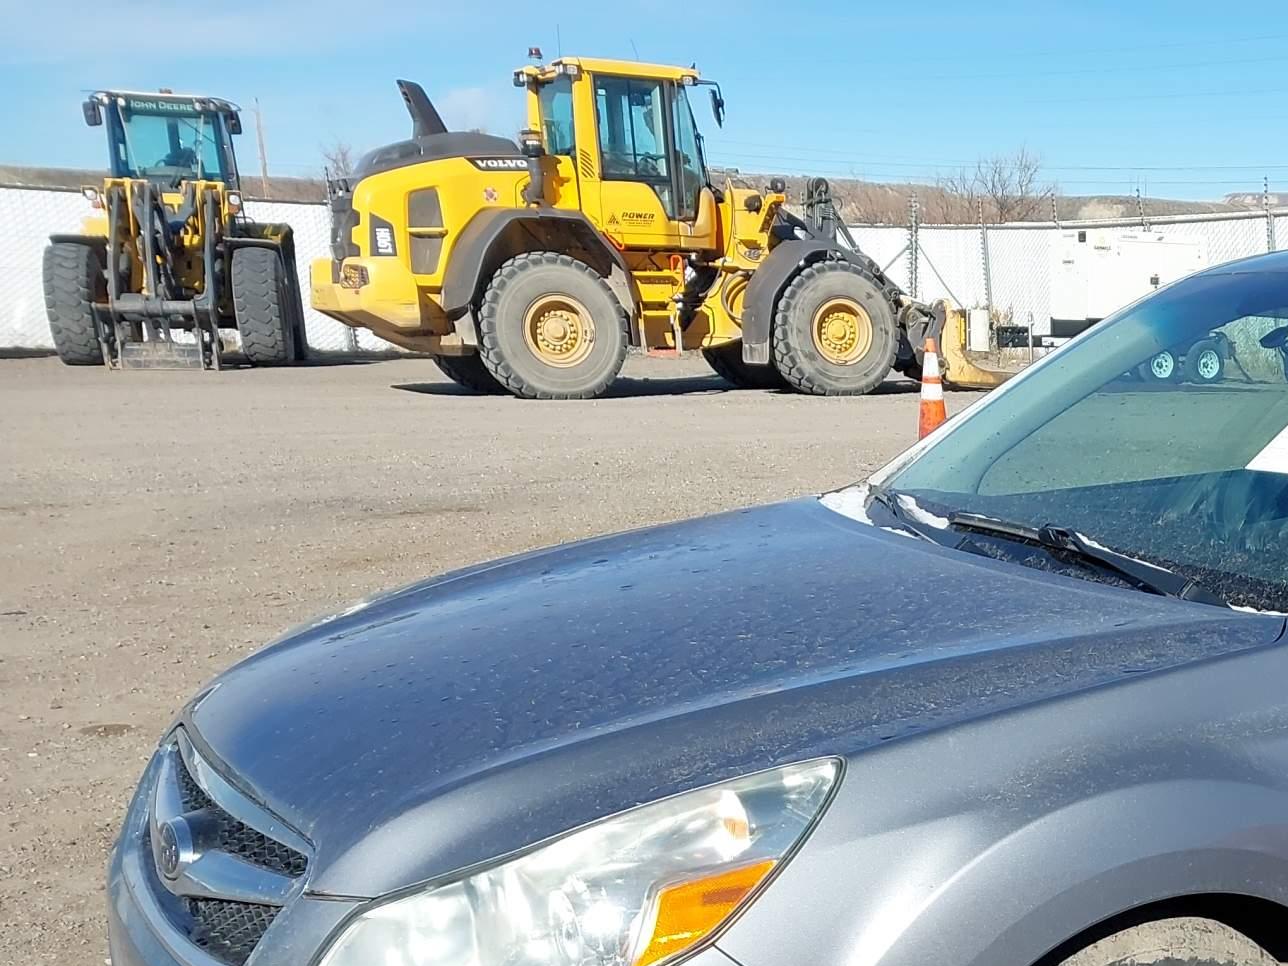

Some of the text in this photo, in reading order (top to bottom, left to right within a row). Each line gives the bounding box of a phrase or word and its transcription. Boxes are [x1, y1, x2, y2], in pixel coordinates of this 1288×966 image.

[130, 99, 194, 111] JOHN DEERE
[475, 159, 528, 168] VOLVO
[622, 211, 655, 219] POWER
[376, 227, 393, 253] L90H
